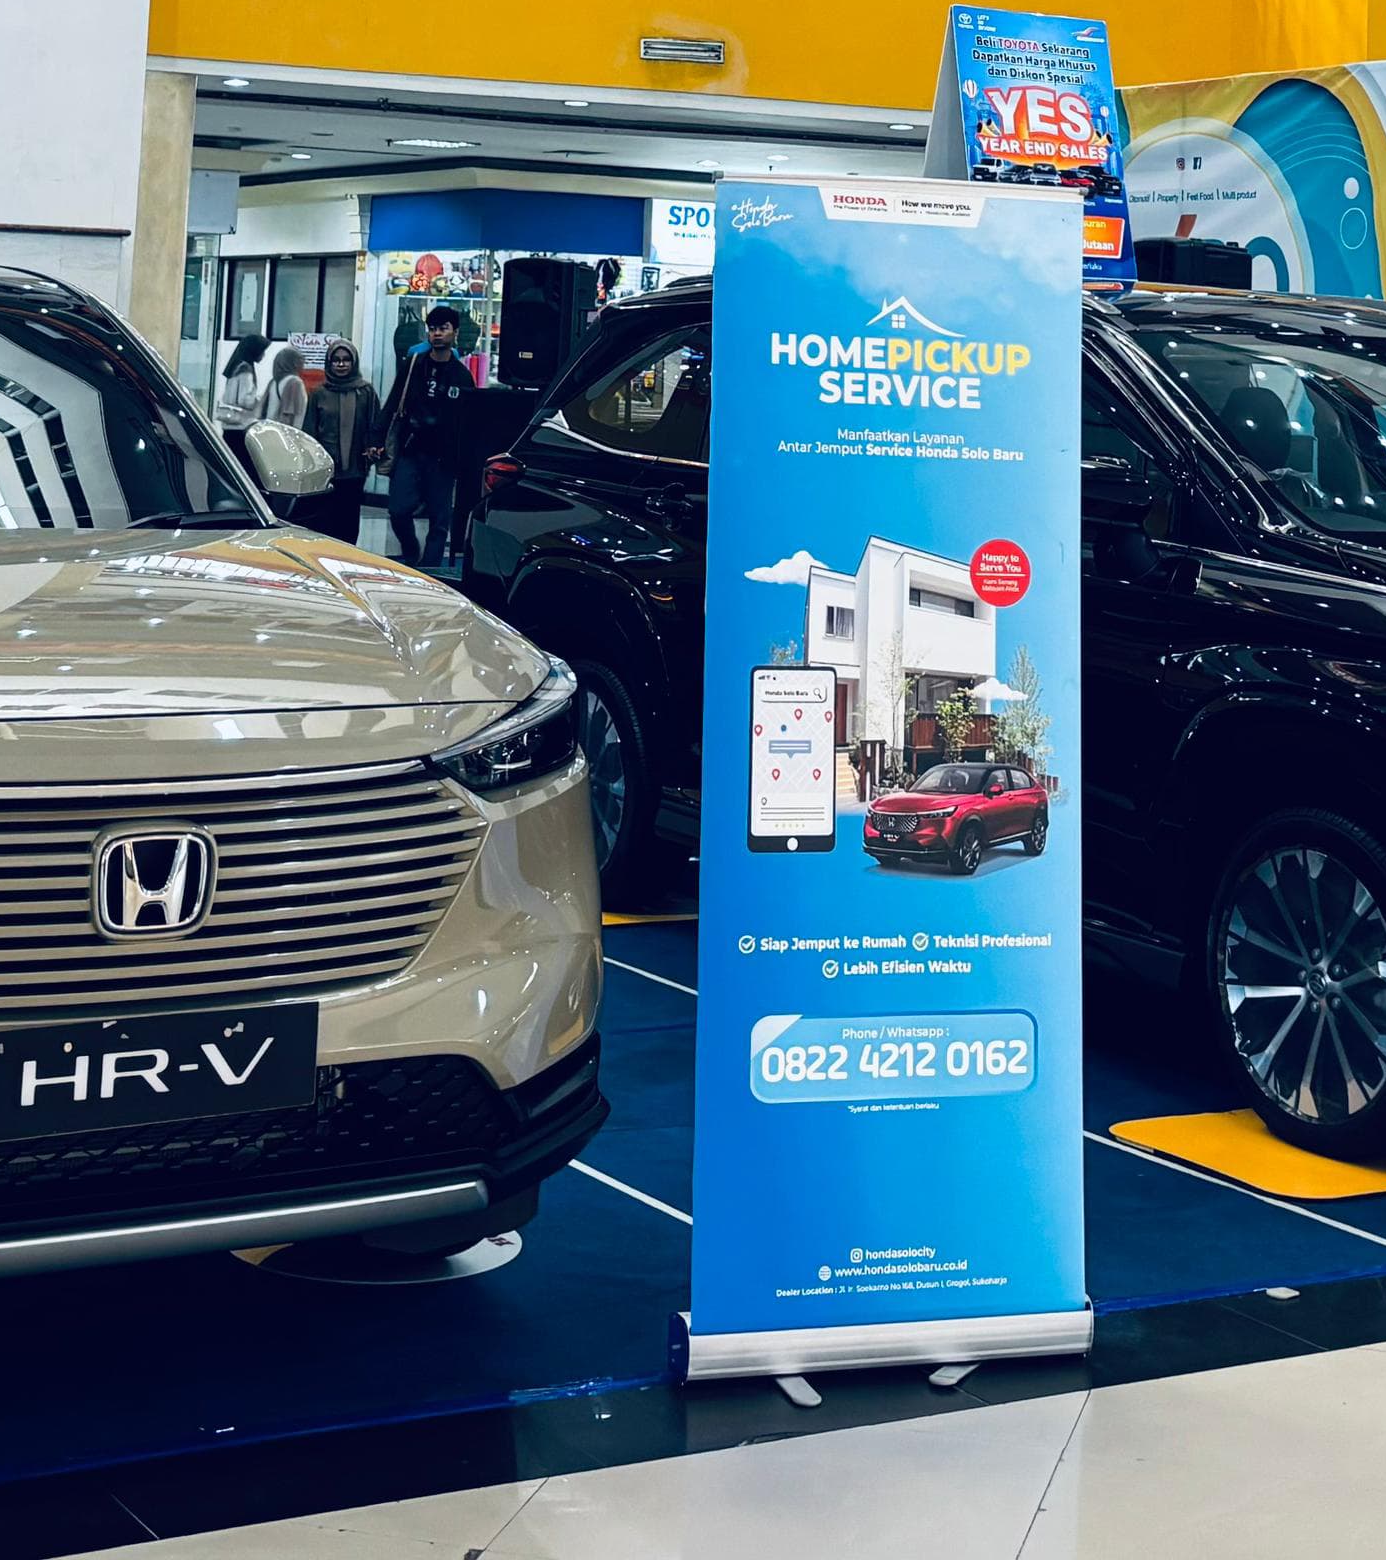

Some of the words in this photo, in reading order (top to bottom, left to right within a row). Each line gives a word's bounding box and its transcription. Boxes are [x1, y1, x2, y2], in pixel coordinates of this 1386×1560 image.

[976, 36, 996, 48] Beli
[998, 38, 1039, 52] TOYOTA
[1041, 42, 1090, 59] Sekarang
[972, 49, 1023, 65] Dapatkan
[1025, 55, 1056, 70] Harga
[1058, 58, 1096, 72] Khusus
[988, 66, 1008, 78] dan
[1009, 68, 1045, 82] Diskon
[1047, 72, 1085, 85] Spesial
[986, 88, 1093, 141] YES
[980, 134, 1020, 153] YEAR
[1024, 140, 1055, 157] END
[1060, 145, 1108, 161] SALES
[833, 195, 887, 206] HONDA
[1237, 191, 1257, 200] product
[819, 372, 981, 409] SERVICE
[837, 427, 910, 443] Manfaatkan
[913, 431, 965, 446] Layanan
[778, 441, 812, 454] Antar
[815, 442, 863, 458] Jemput
[865, 444, 913, 458] Service
[916, 446, 959, 459] Honda
[961, 447, 989, 460] Solo
[992, 449, 1024, 462] Baru
[980, 563, 1003, 572] Serve
[1005, 563, 1021, 572] You
[981, 553, 1009, 564] Happy
[760, 937, 790, 953] Siap
[791, 937, 841, 953] Jemput
[843, 937, 859, 950] ke
[861, 935, 907, 949] Rumah
[933, 935, 979, 949] Teknisi
[981, 933, 1052, 948] Profesional
[843, 961, 878, 976] Lebih
[882, 960, 925, 975] Efisien
[927, 959, 971, 974] Waktu
[842, 1026, 879, 1041] Phone
[886, 1025, 944, 1040] Whatsapp
[762, 1045, 848, 1083] 0822
[859, 1041, 936, 1078] 4212
[946, 1039, 1028, 1076] 0162
[20, 1037, 274, 1106] HR-V
[866, 1246, 936, 1260] hondasolocity
[835, 1260, 967, 1278] www.hondasolobaru.co.id
[776, 1288, 801, 1298] Dealer
[801, 1286, 834, 1297] Location
